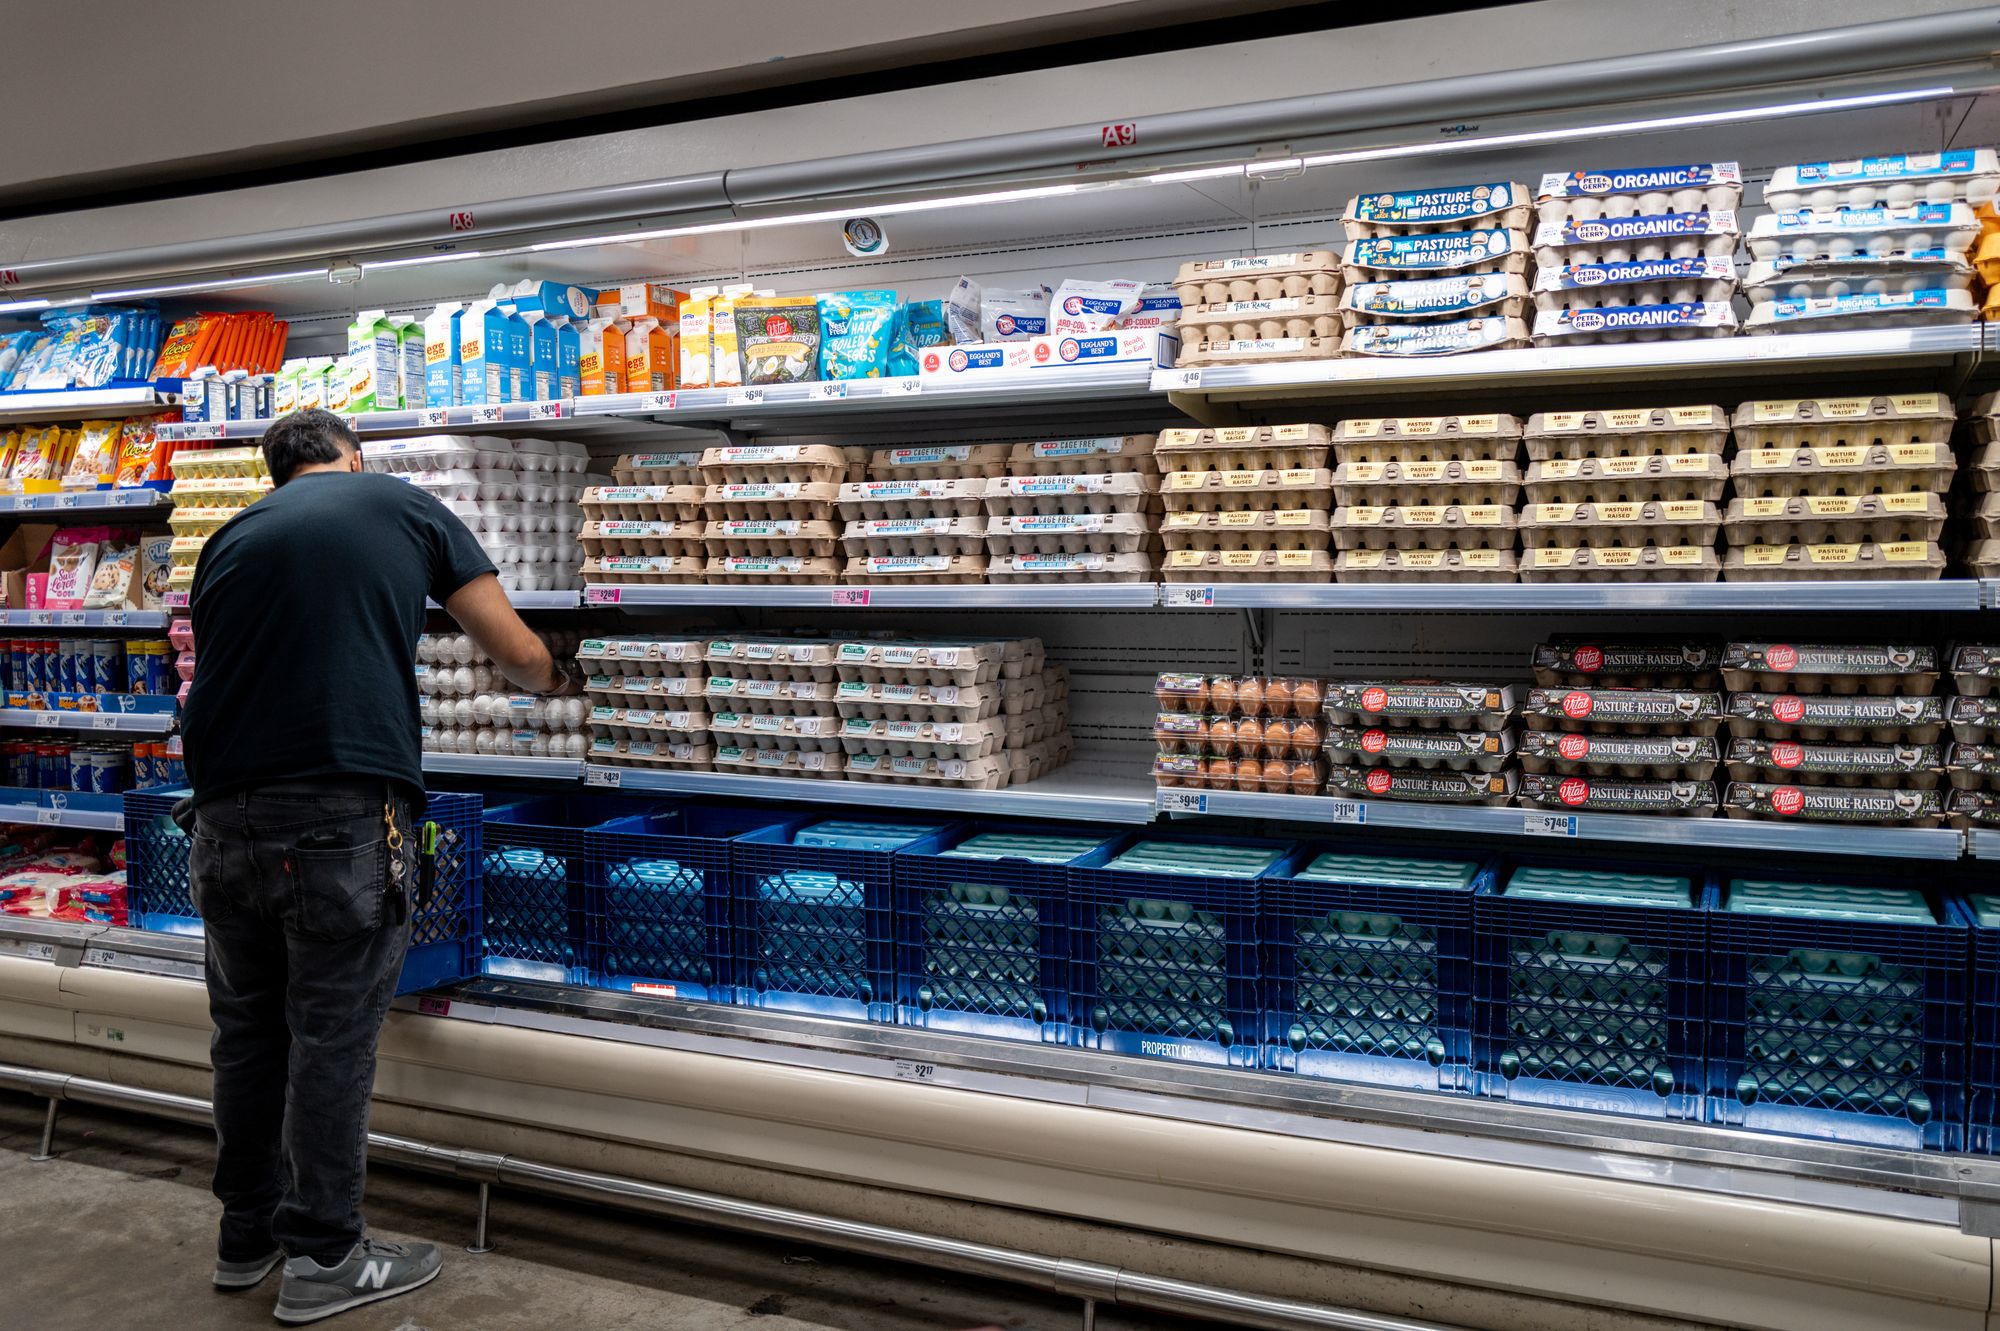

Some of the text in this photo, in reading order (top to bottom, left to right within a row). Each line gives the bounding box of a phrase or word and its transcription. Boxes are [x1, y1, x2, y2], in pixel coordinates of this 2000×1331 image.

[1104, 123, 1135, 148] A9
[1864, 161, 1904, 173] ORGANIC
[1613, 171, 1687, 189] ORGANIC
[1415, 191, 1471, 207] PASTURE
[1421, 203, 1465, 217] RAISED
[452, 212, 474, 231] A8
[1843, 212, 1882, 223] ORGANIC
[1611, 219, 1685, 238] ORGANIC
[1414, 237, 1470, 251] PASTURE
[1419, 249, 1465, 263] RAISED
[1608, 263, 1682, 281] ORGANIC
[1416, 294, 1463, 308] RAISED
[1839, 298, 1879, 309] ORGANIC
[1606, 310, 1680, 327] ORGANIC
[767, 320, 787, 336] Vital
[1410, 324, 1467, 338] PASTURE
[462, 340, 479, 353] egg
[1123, 335, 1143, 347] Ready
[1416, 335, 1462, 349] RAISED
[427, 342, 445, 355] egg
[1009, 349, 1027, 360] Ready
[581, 355, 597, 367] egg
[628, 356, 644, 368] egg
[929, 356, 935, 364] 6
[1576, 651, 1600, 666] Vital
[1604, 654, 1683, 666] PASTURE-RAISED
[1766, 650, 1793, 664] Vital
[1799, 653, 1888, 666] PASTURE-RAISED
[1363, 691, 1384, 706] Vital
[1387, 695, 1463, 709] PASTURE-RAISED
[1563, 696, 1589, 712] Vital
[1593, 700, 1675, 714] PASTURE-RAISED
[1773, 700, 1800, 715] Vital
[1805, 704, 1896, 717] PASTURE-RAISED
[1363, 733, 1384, 747] Vital
[1386, 738, 1462, 752] PASTURE-RAISED
[1559, 738, 1585, 754] Vital
[1589, 742, 1671, 756] PASTURE-RAISED
[1772, 746, 1799, 761] Vital
[1804, 751, 1894, 764] PASTURE-RAISED
[1367, 774, 1389, 787] Vital
[1391, 778, 1467, 793] PASTURE-RAISED
[1559, 782, 1585, 798] Vital
[1590, 787, 1672, 801] PASTURE-RAISED
[1772, 792, 1800, 807] Vital
[1804, 797, 1894, 811] PASTURE-RAISED
[1545, 817, 1567, 830] $746
[1141, 1041, 1192, 1057] PROPERTY OF
[355, 1260, 393, 1289] N
